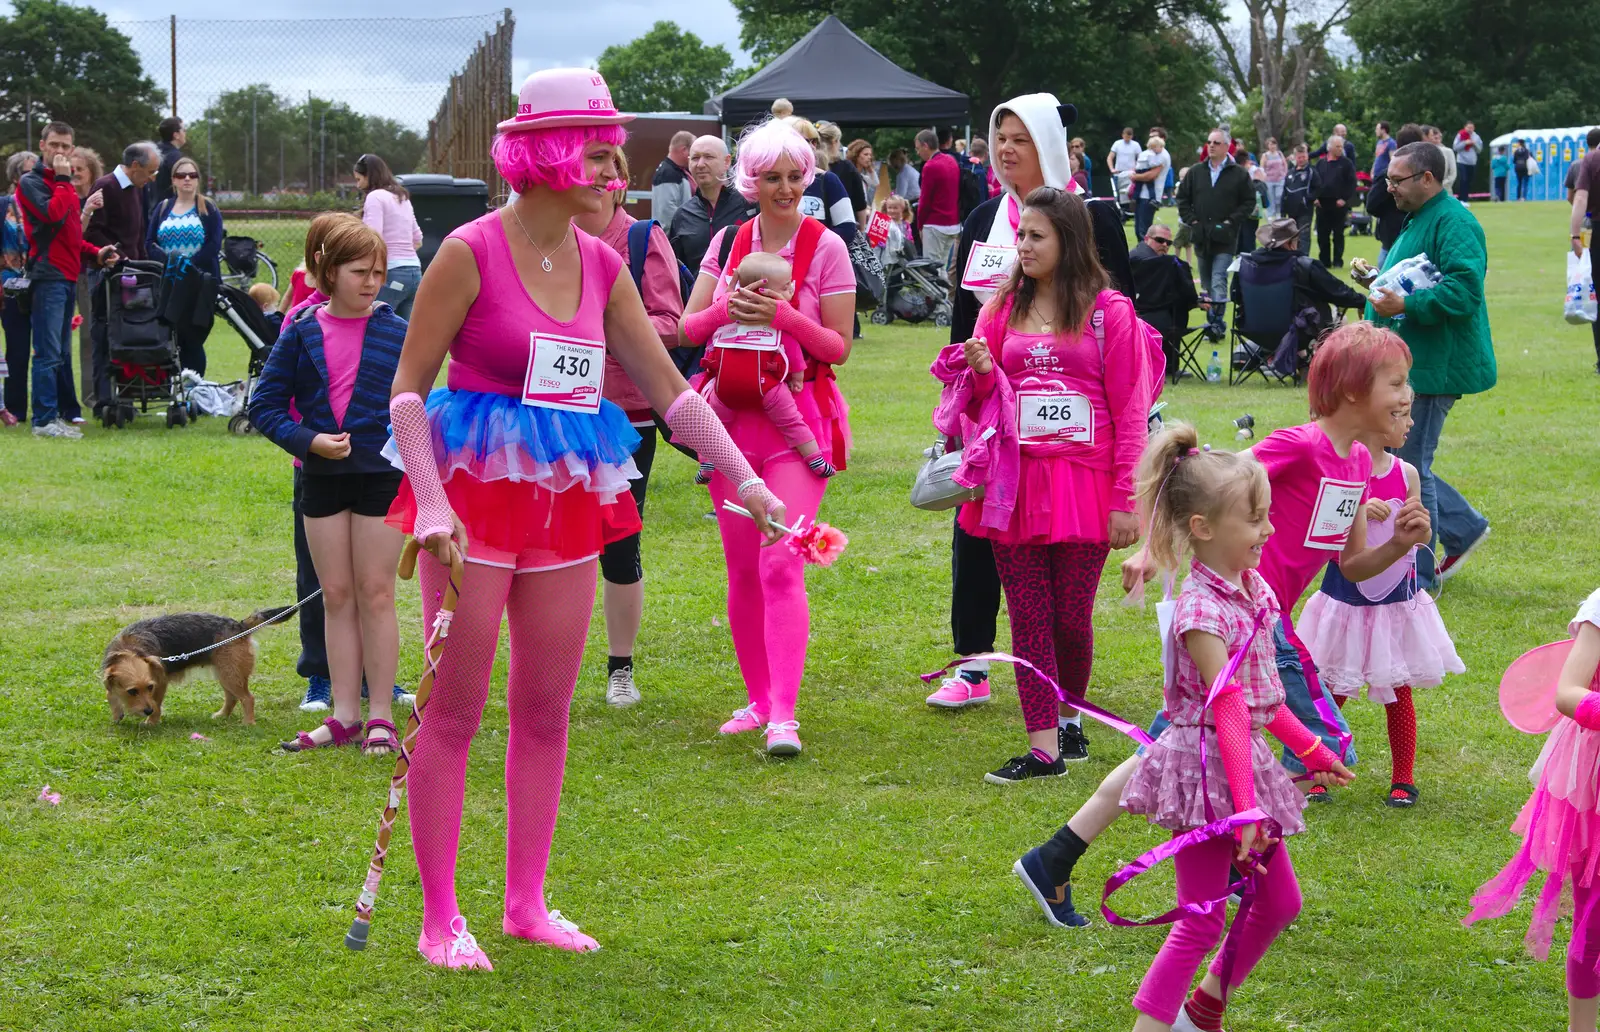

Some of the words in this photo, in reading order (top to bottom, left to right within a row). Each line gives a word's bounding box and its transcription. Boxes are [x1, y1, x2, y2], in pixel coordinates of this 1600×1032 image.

[981, 254, 1004, 268] 354
[556, 344, 567, 352] THE
[567, 346, 593, 356] RANDOMS
[553, 355, 590, 378] 430
[1024, 356, 1059, 367] KEEP
[539, 378, 561, 387] TESCO
[1037, 405, 1071, 420] 426
[1336, 499, 1357, 517] 431
